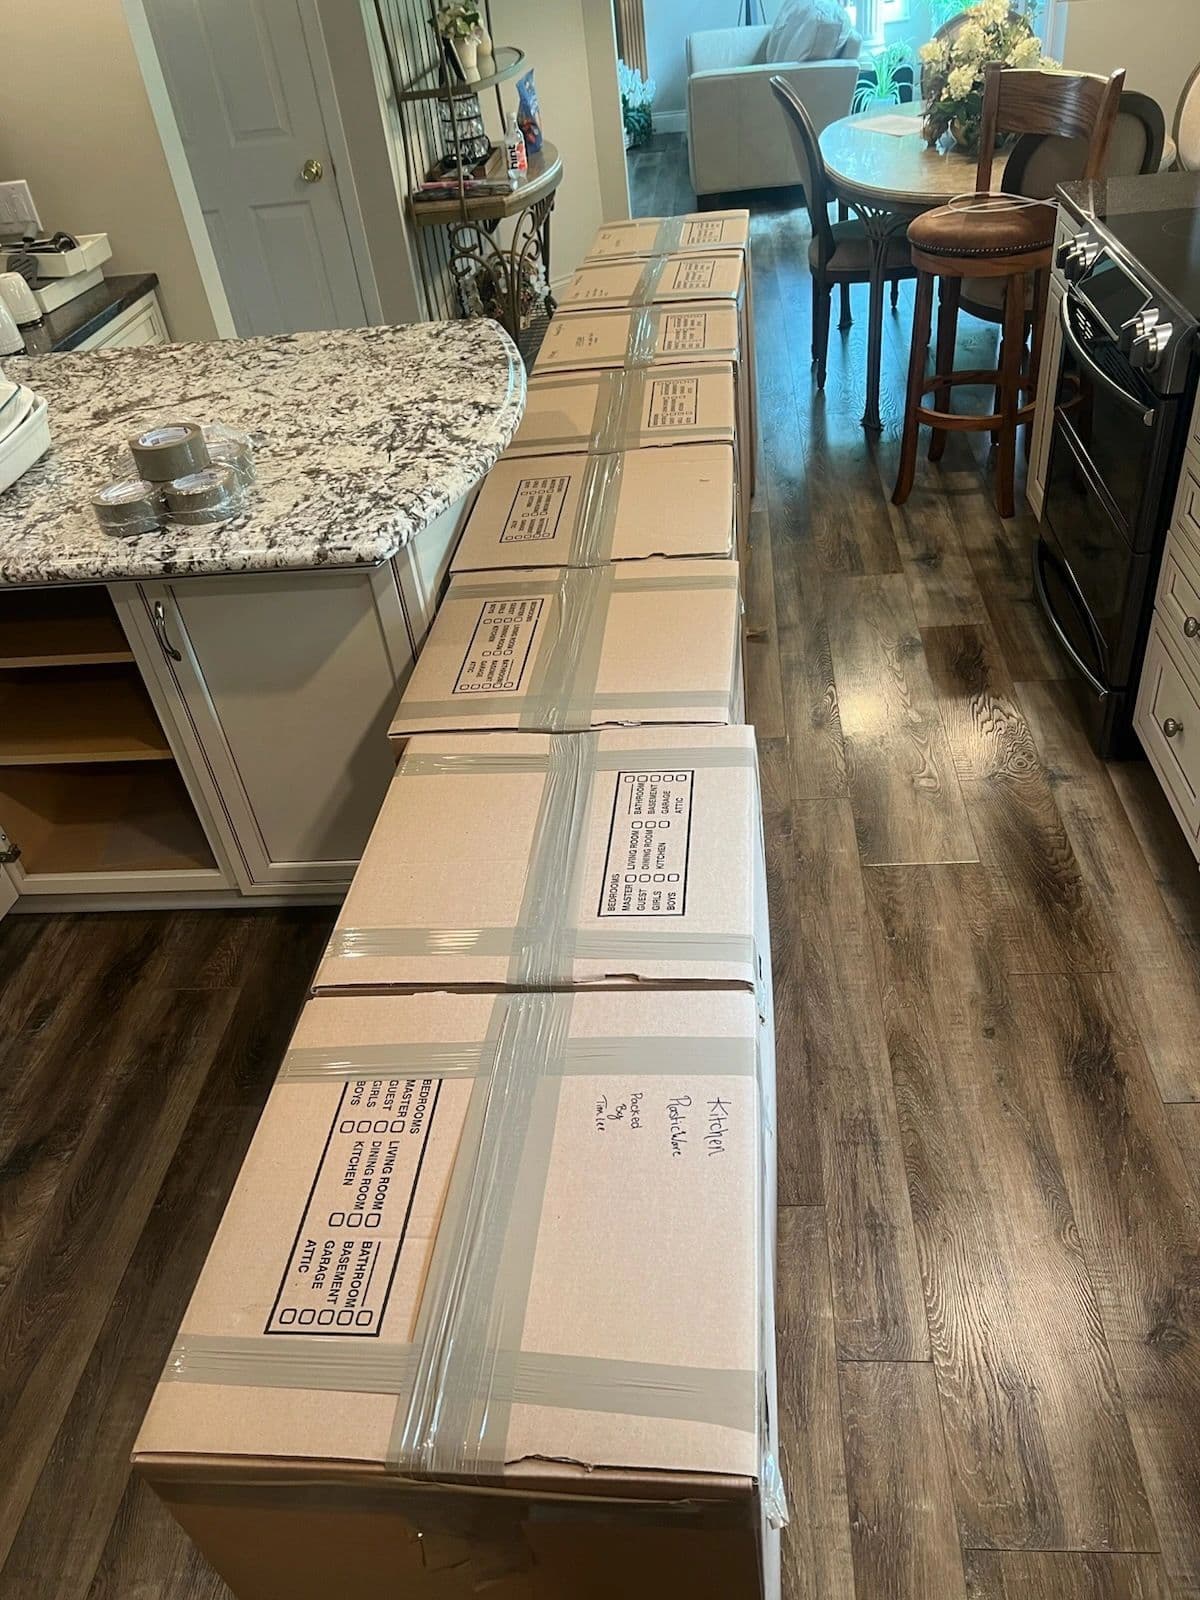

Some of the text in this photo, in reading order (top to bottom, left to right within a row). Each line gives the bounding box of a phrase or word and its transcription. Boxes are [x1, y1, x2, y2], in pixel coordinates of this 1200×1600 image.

[508, 144, 518, 170] hint
[633, 783, 645, 815] BATHROOM
[648, 784, 658, 815] BASEMENT
[661, 790, 671, 815] GARAGE
[675, 797, 684, 814] ATTIC
[627, 830, 639, 870] LIVING ROOM
[641, 829, 653, 870] DINING ROOM
[656, 842, 666, 870] KITCHEN
[607, 873, 620, 911] BEDROOMS
[621, 884, 633, 911] MASTER
[636, 888, 648, 911] GUEST
[651, 890, 662, 911] GIRLS
[666, 892, 676, 911] BOYS
[350, 1081, 366, 1106] BOYS
[366, 1080, 382, 1108] GIRLS
[382, 1080, 399, 1111] GUEST
[396, 1079, 416, 1118] MASTER
[409, 1079, 432, 1135] BEDROOMS
[606, 1103, 627, 1120] By
[629, 1092, 644, 1129] Packed
[703, 1097, 732, 1157] Kitchen
[342, 1141, 365, 1186] KITCHEN
[353, 1141, 382, 1210] DINING ROOM
[372, 1141, 401, 1210] LIVING ROOM
[298, 1239, 317, 1273] ATTIC
[311, 1240, 336, 1290] GARAGE
[327, 1241, 355, 1305] BASEMENT
[344, 1241, 373, 1308] BATHROOM
